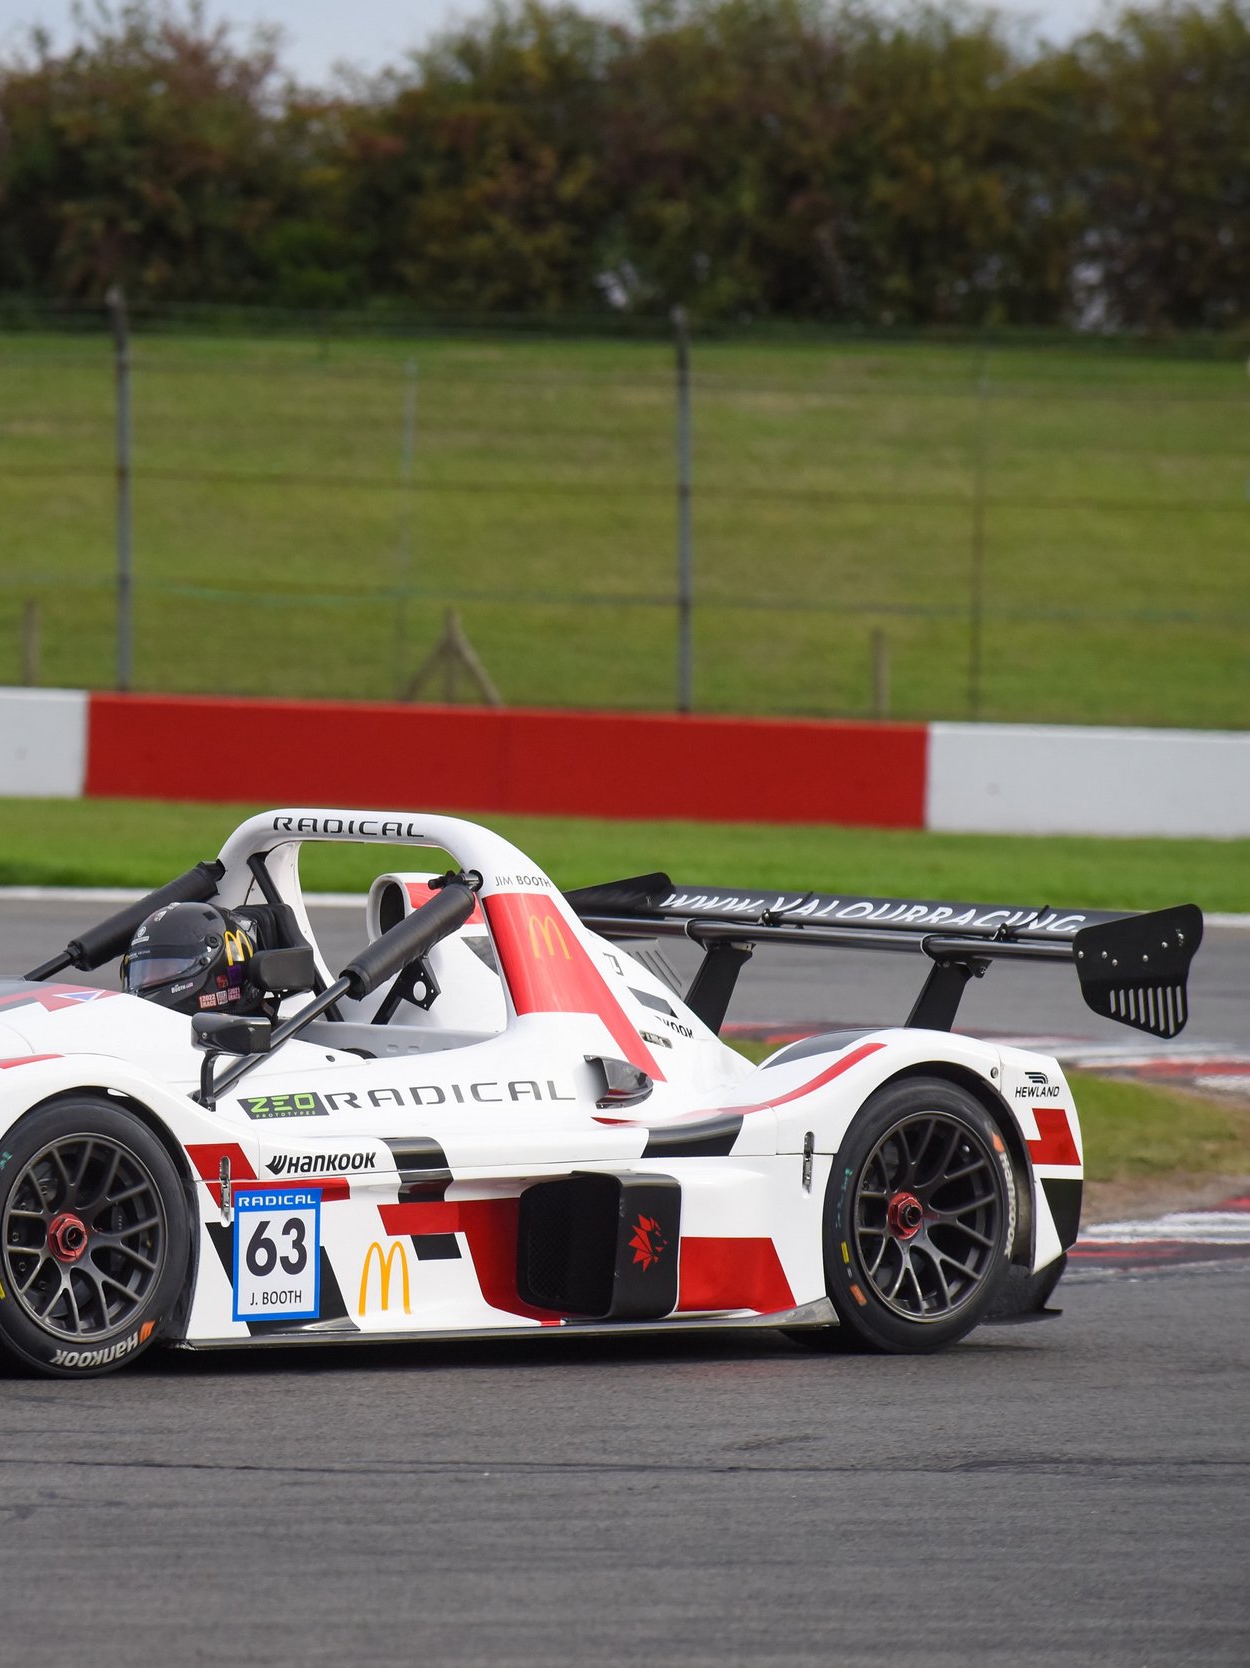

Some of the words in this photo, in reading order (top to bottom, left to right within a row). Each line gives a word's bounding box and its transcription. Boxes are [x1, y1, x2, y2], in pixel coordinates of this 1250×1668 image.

[273, 816, 425, 838] RADICAL
[495, 876, 513, 887] JIM
[516, 875, 552, 888] BOOTH
[247, 1093, 316, 1113] ZEO
[323, 1080, 576, 1111] RADICAL
[1015, 1086, 1060, 1098] HEWLAND
[256, 1110, 316, 1119] PROTOTYPES
[238, 1194, 317, 1208] RADICAL
[246, 1217, 308, 1277] 63
[250, 1292, 259, 1306] J.
[262, 1290, 302, 1305] BOOTH
